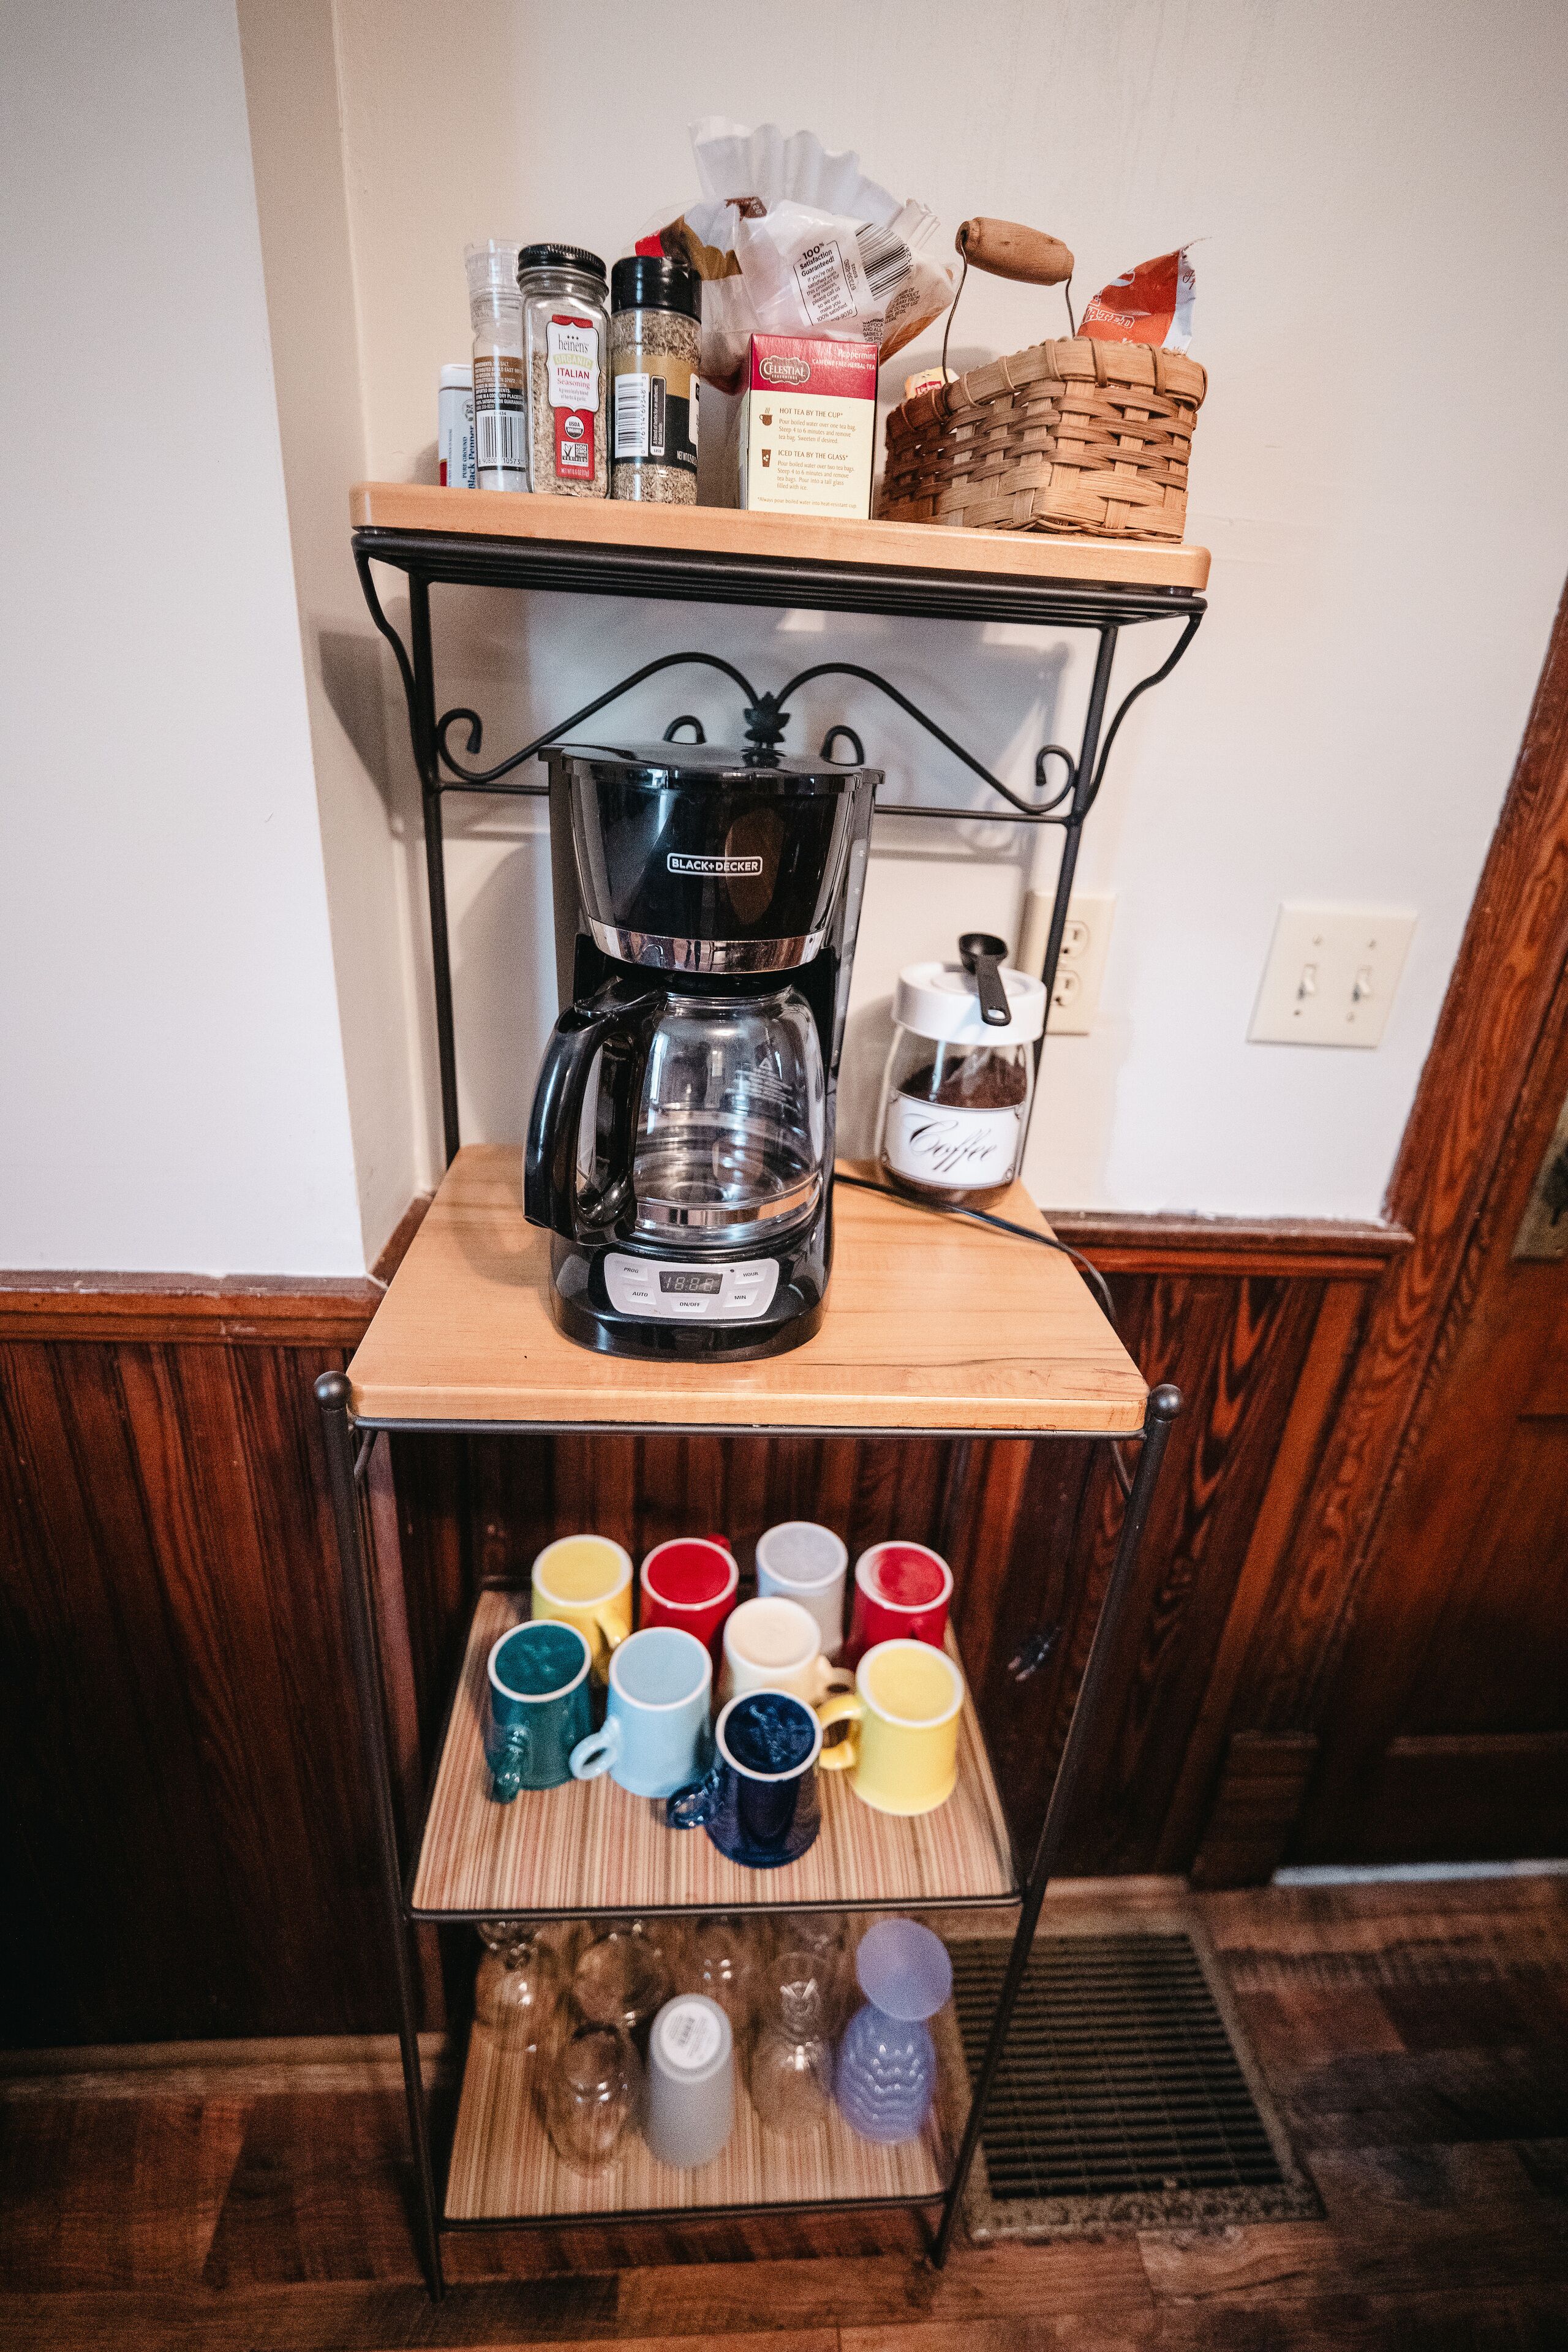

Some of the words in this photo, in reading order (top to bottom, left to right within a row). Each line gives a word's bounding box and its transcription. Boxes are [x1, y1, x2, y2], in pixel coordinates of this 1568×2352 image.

[802, 241, 824, 260] 100%
[799, 249, 832, 270] Satisfaction
[801, 256, 835, 277] Guaranteed!
[807, 276, 827, 289] satisfied
[826, 271, 837, 279] with
[811, 270, 826, 282] you're
[826, 266, 834, 274] not
[806, 287, 815, 296] this
[815, 279, 834, 294] product
[812, 290, 821, 299] any
[821, 282, 837, 294] reason,
[812, 293, 827, 306] please
[831, 293, 839, 302] can
[820, 304, 833, 314] make
[832, 300, 842, 309] you
[816, 312, 829, 323] 100%
[555, 354, 592, 368] ORGANIC
[837, 349, 876, 360] Peppermint
[557, 368, 590, 380] ITALIAN
[763, 361, 806, 377] CELESTIAL
[557, 379, 590, 390] Seasoning
[671, 858, 758, 873] BLACK+DECKER
[902, 1113, 997, 1172] Coffee
